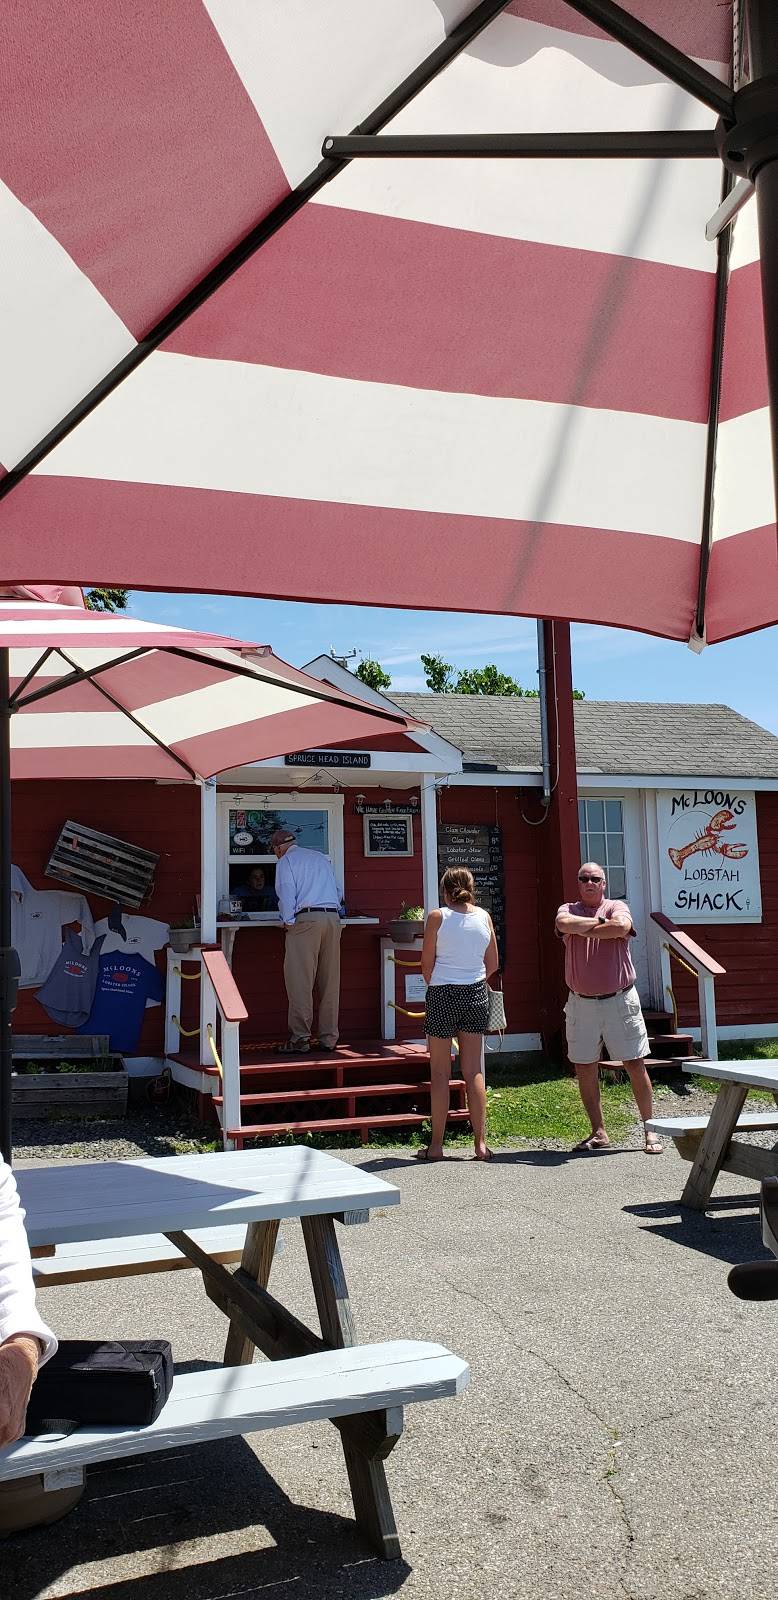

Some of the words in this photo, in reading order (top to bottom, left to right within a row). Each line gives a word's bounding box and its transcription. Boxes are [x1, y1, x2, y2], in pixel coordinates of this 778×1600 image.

[288, 754, 316, 763] SPRUCE
[318, 755, 339, 763] HEAD
[342, 756, 369, 764] ISLAND
[684, 868, 740, 882] LOBSTAH
[674, 889, 744, 911] SHACK
